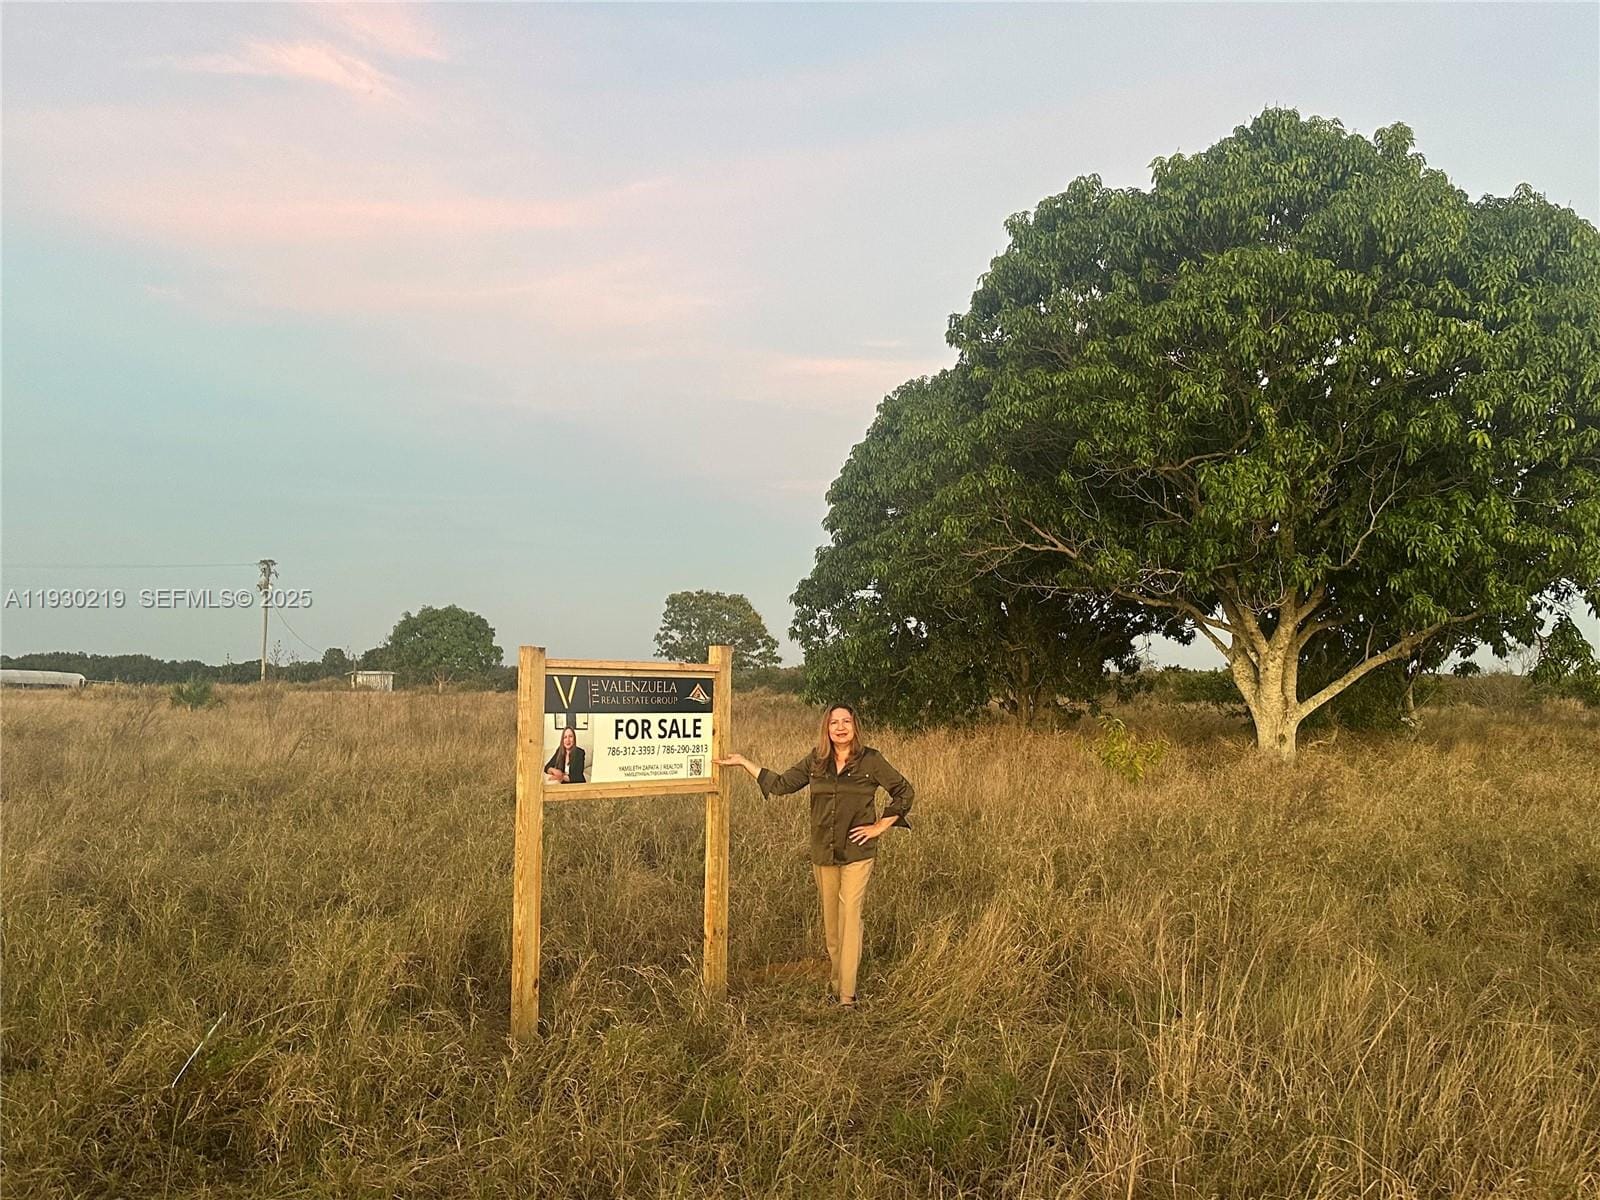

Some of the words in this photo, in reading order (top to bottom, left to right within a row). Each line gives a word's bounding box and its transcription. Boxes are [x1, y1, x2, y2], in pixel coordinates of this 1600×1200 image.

[591, 680, 599, 705] THE
[600, 679, 678, 693] VALENZUELA
[601, 696, 620, 705] REAL
[622, 696, 649, 705] ESTATE
[650, 696, 678, 705] GROUP
[614, 718, 652, 740] FOR
[657, 718, 702, 740] SALE
[607, 746, 656, 757] 786-312-3393
[662, 744, 709, 755] 786-290-2813
